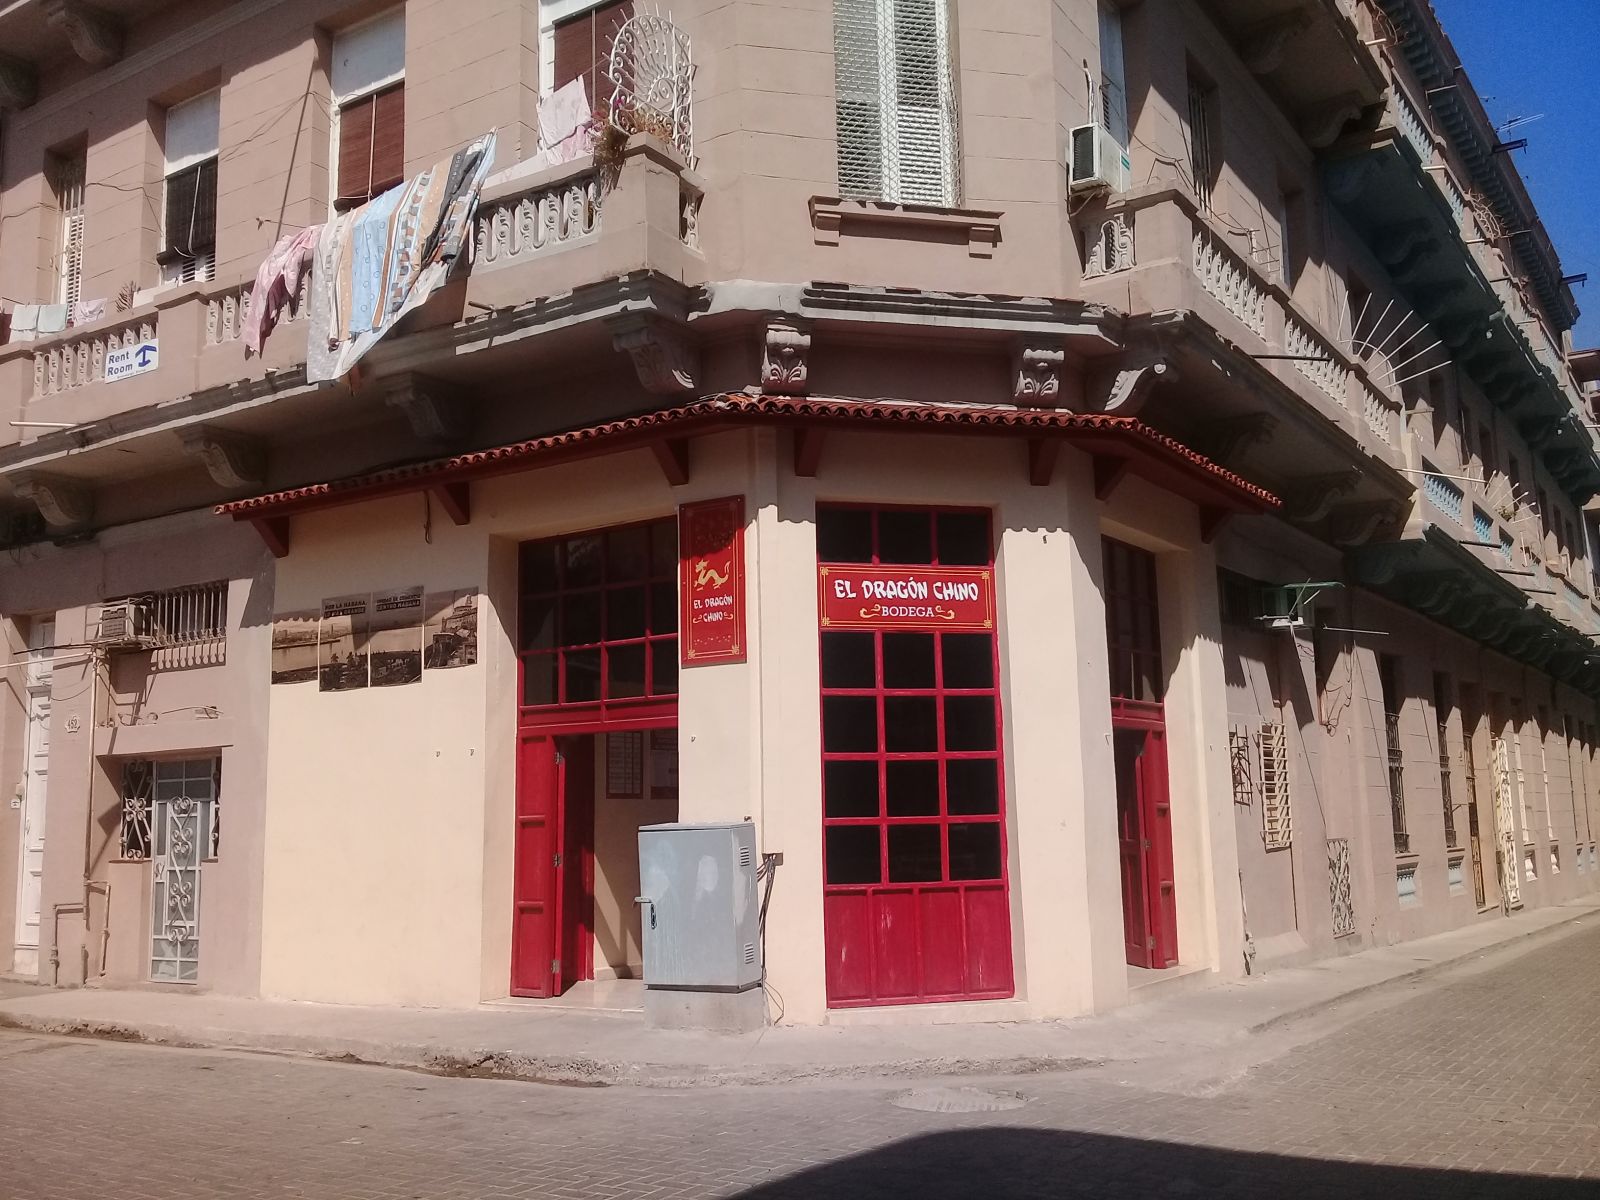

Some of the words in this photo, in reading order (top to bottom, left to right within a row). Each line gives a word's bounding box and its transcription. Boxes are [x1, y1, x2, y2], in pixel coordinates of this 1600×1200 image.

[109, 351, 129, 364] Rent
[107, 364, 133, 376] Room
[834, 580, 857, 598] EL
[861, 577, 928, 599] DRAGÓN
[932, 582, 979, 601] CHINO
[693, 599, 703, 609] EL
[704, 594, 733, 608] DRAGÓN
[703, 611, 723, 622] CHINO
[881, 606, 935, 617] BODEGA
